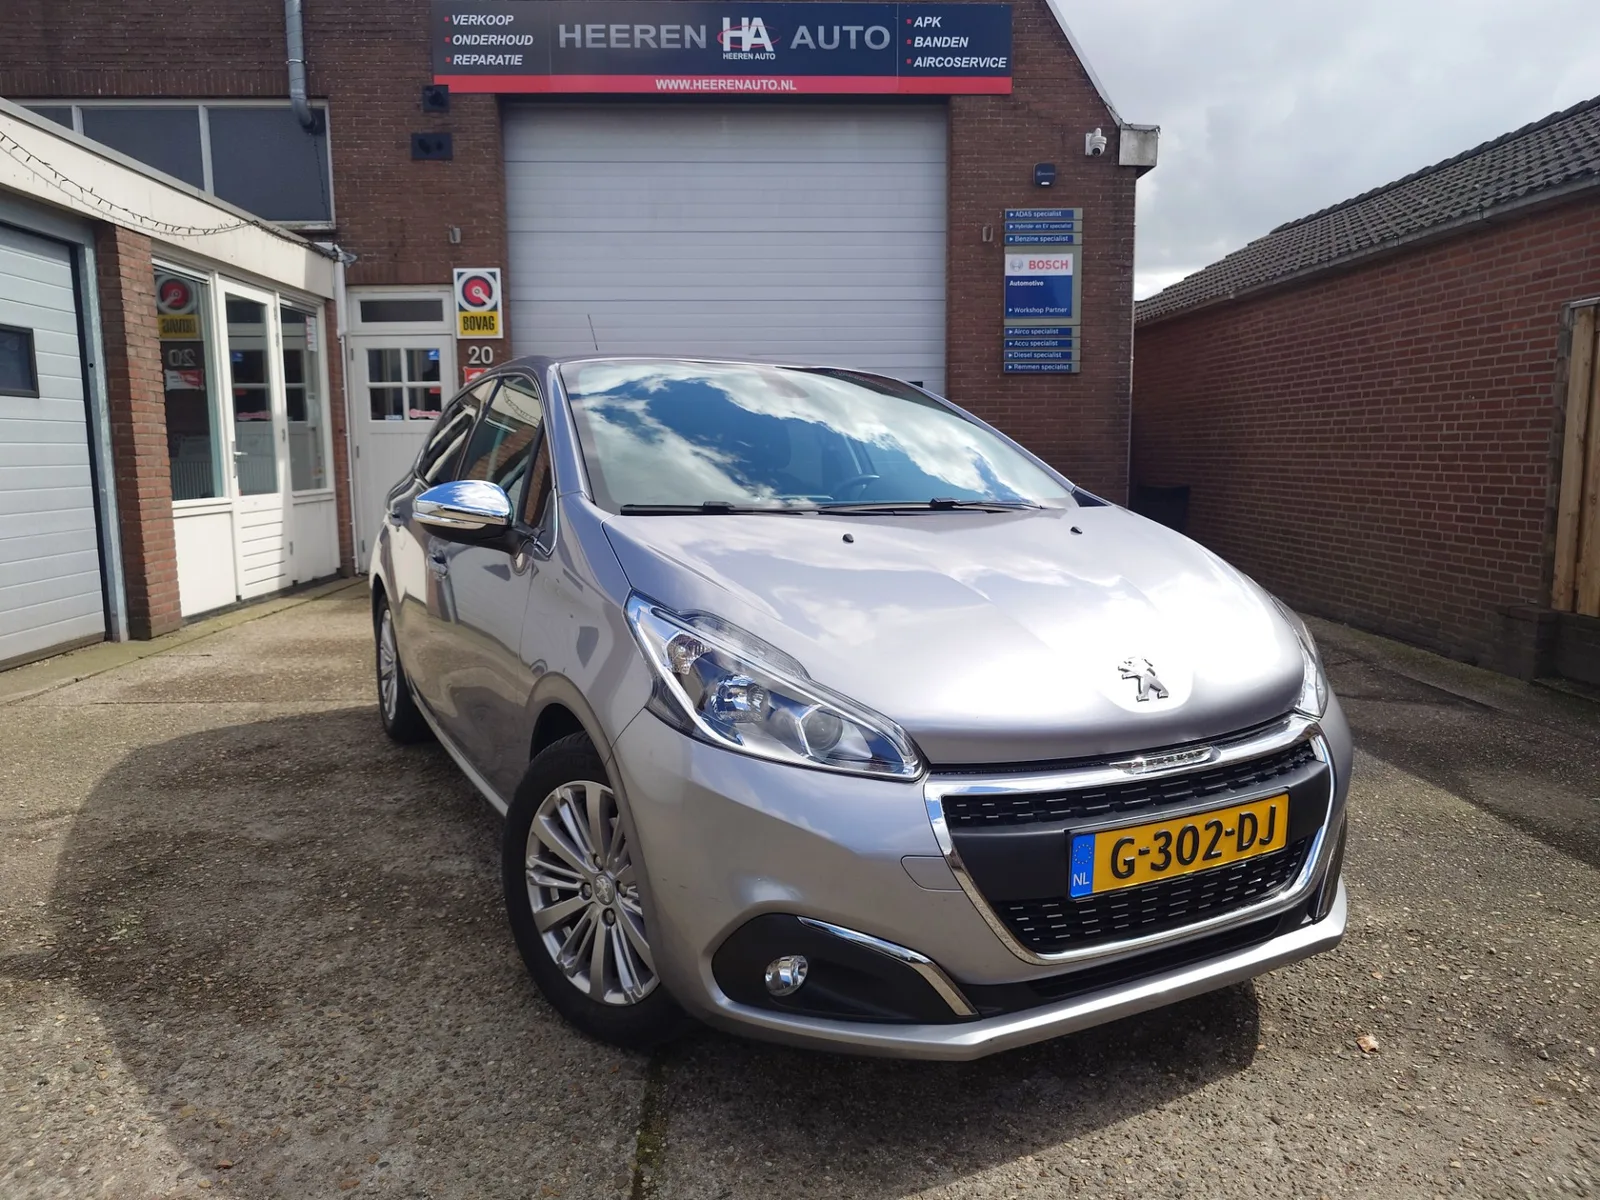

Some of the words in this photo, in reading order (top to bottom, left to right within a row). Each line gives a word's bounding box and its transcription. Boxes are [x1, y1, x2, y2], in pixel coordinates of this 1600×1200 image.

[452, 15, 514, 26] VERKOOP
[913, 16, 942, 28] APK
[452, 34, 534, 46] ONDERHOUD
[559, 24, 707, 49] HEEREN
[790, 25, 891, 50] AUTO
[722, 17, 774, 52] HA
[914, 37, 969, 48] BANDEN
[453, 54, 523, 66] REPARATIE
[913, 57, 1007, 68] AIRCOSERVICE
[655, 79, 797, 91] WWW.HEERENAUTO.NL
[1029, 260, 1069, 270] BOSCH
[463, 316, 495, 331] BOVAG
[468, 346, 494, 365] 20
[1073, 872, 1090, 887] NL
[1110, 805, 1276, 880] G-302-DJ
